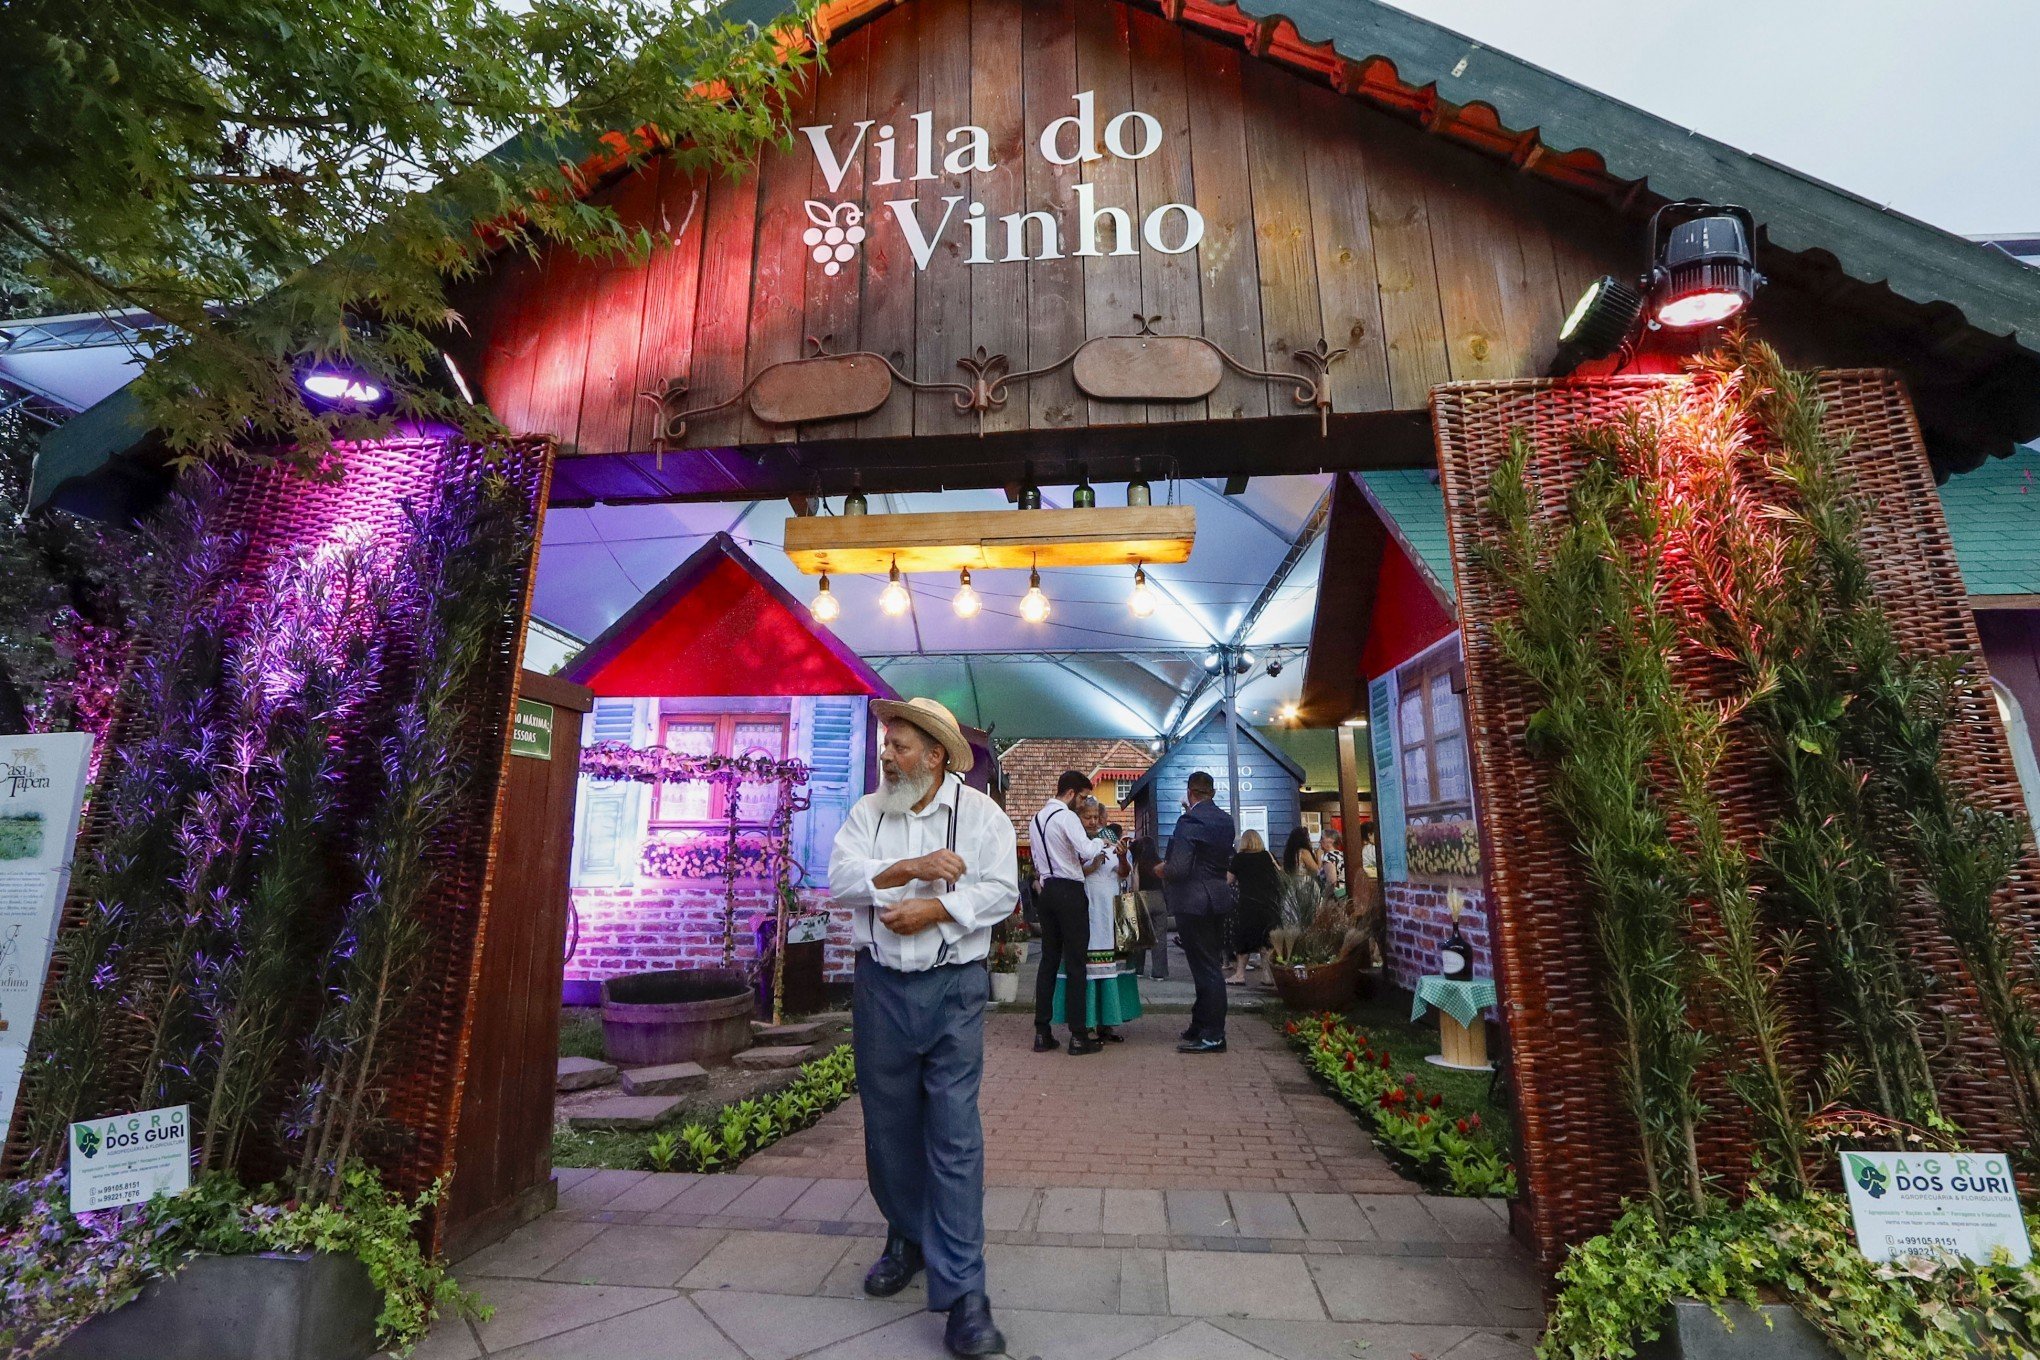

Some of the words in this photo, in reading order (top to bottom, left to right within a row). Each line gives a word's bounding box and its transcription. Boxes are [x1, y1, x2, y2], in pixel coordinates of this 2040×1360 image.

[799, 110, 997, 193] Vila
[1040, 90, 1163, 165] do
[883, 183, 1205, 271] Vinho
[514, 729, 537, 743] ESSOAS
[8, 776, 50, 798] Tapera
[106, 1111, 184, 1136] AGRO
[106, 1132, 139, 1149] DOS
[144, 1124, 185, 1142] GURI
[1895, 1159, 2003, 1175] AGRO
[1896, 1175, 1944, 1191] DOS
[1951, 1176, 2009, 1193] GURI
[1905, 1237, 1957, 1246] 991058151
